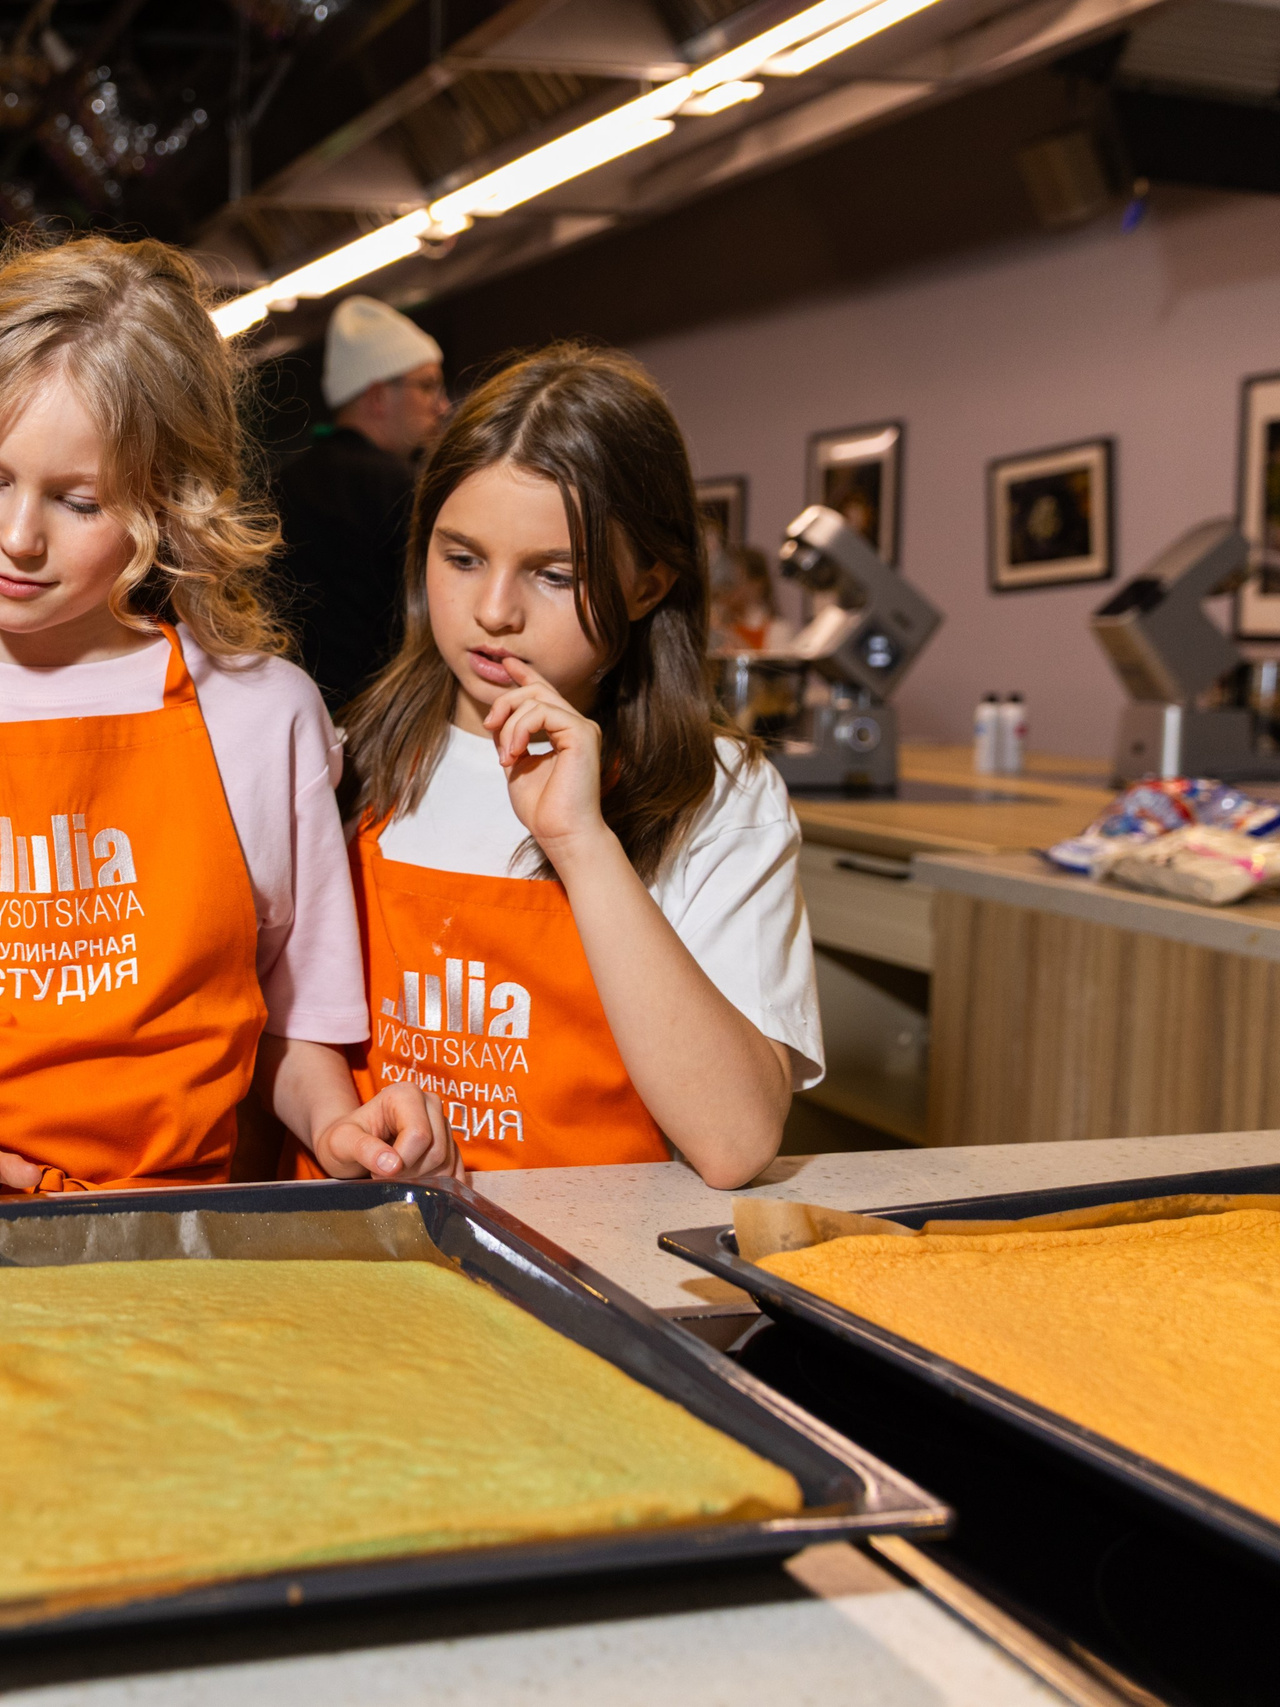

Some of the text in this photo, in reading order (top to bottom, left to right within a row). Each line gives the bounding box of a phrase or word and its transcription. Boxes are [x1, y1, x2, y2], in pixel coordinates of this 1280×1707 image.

[377, 1019, 530, 1074] VYSOTSKAYA
[381, 1062, 519, 1104] КУЛИНАРНАЯ
[448, 1101, 525, 1142] ДИЯ
